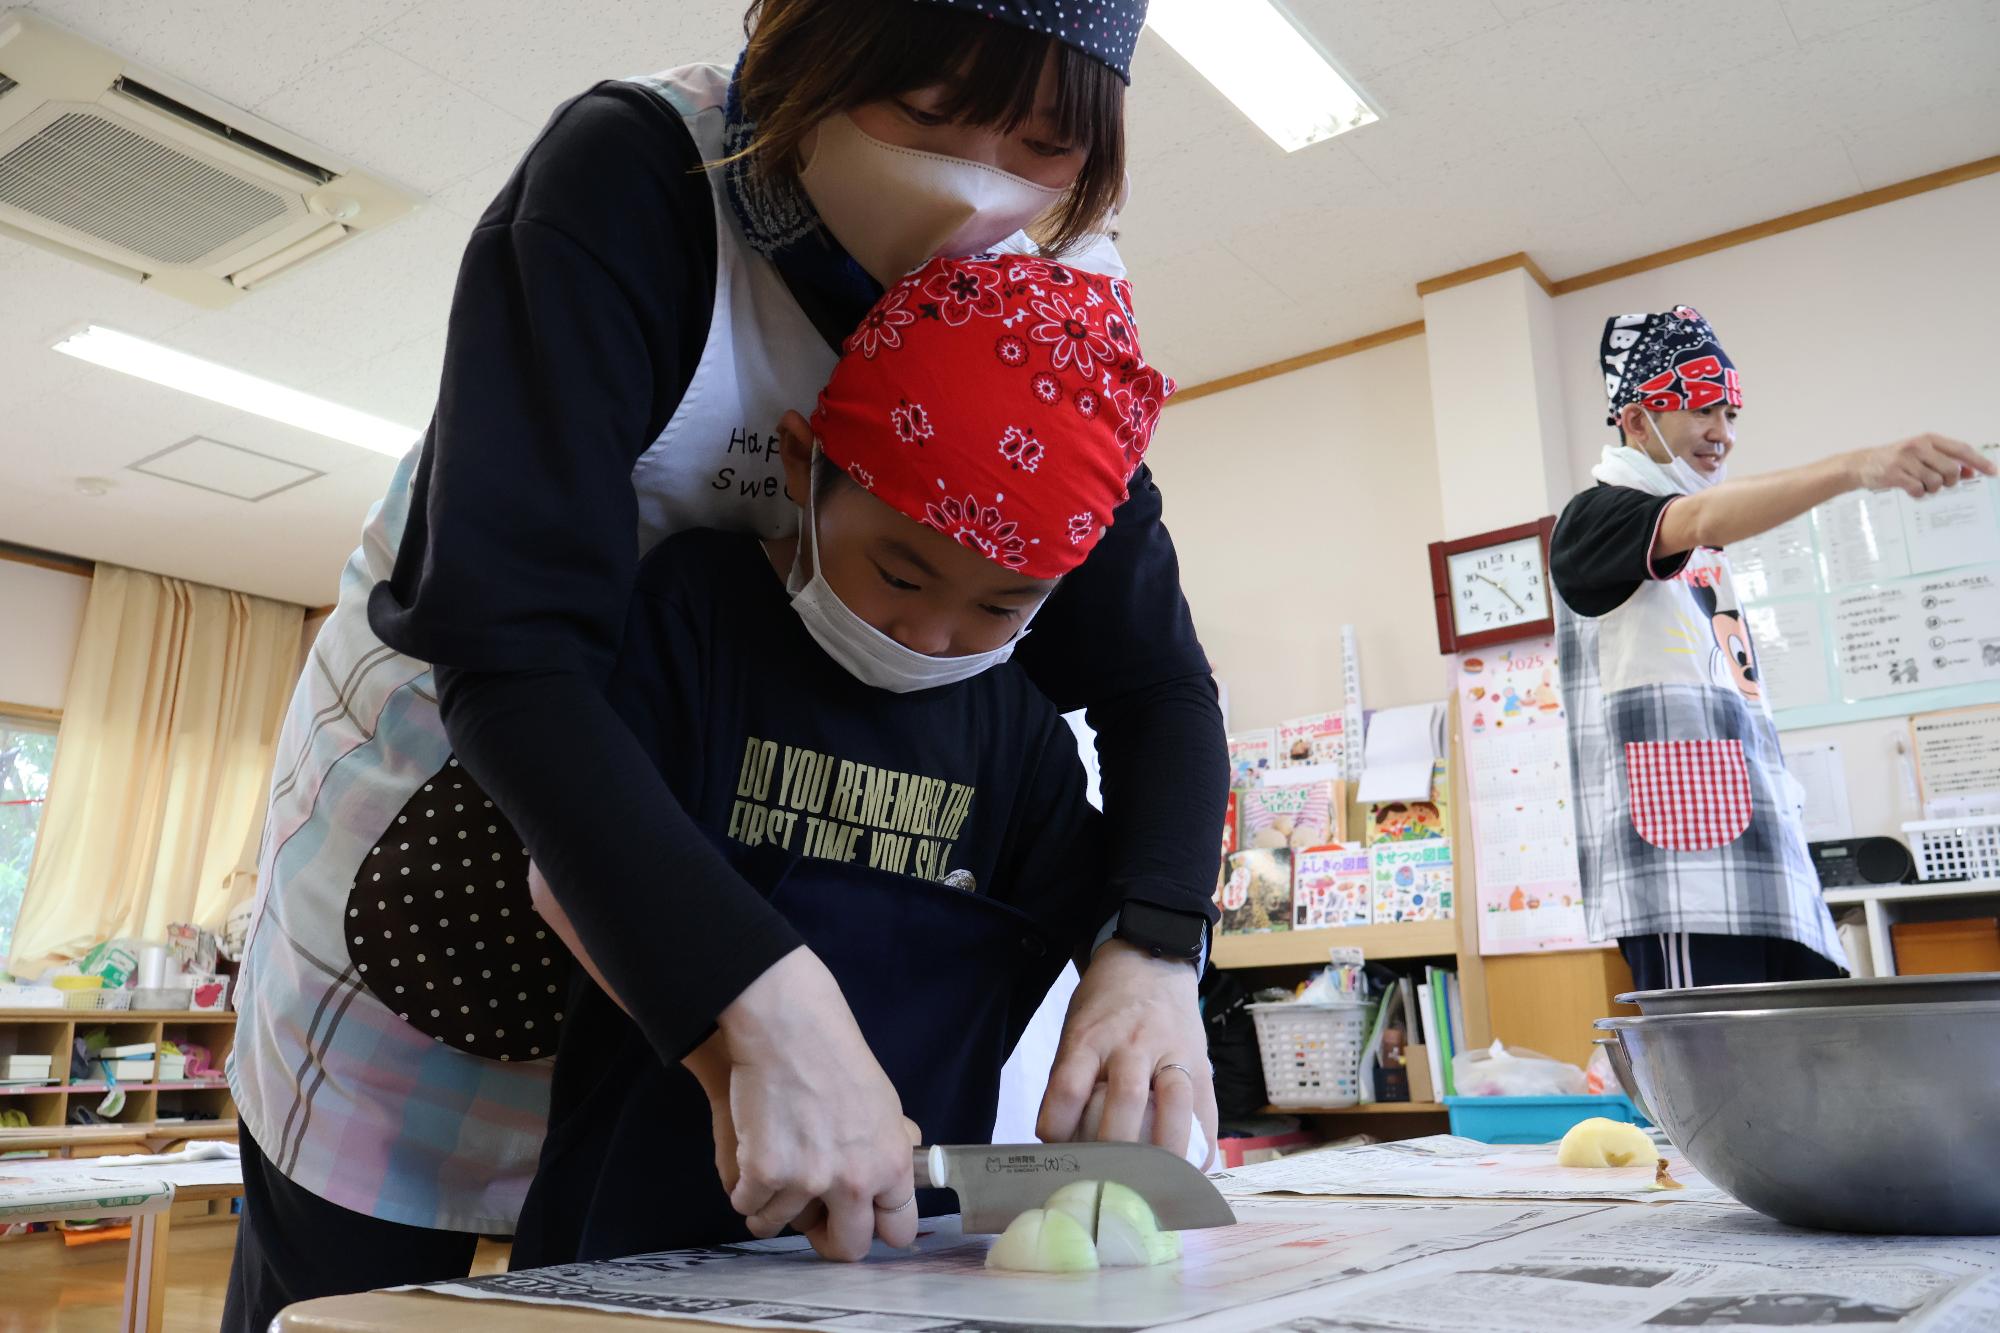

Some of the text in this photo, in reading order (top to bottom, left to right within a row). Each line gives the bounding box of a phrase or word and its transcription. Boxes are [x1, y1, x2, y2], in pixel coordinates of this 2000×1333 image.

[1490, 554, 1504, 564] 12
[1510, 554, 1516, 562] 1
[1477, 560, 1488, 570] 11
[1522, 560, 1532, 570] 2
[1466, 574, 1478, 582] 10
[1528, 576, 1538, 586] 3
[1463, 590, 1472, 600] 9
[1524, 592, 1534, 601] 4
[1470, 604, 1479, 612] 8
[1484, 612, 1492, 622] 7
[1499, 612, 1508, 622] 6
[1506, 655, 1544, 672] 2025
[736, 736, 976, 841] DO YOU REMEMBER THE
[727, 799, 799, 851] FIRST
[802, 816, 864, 863] TIME
